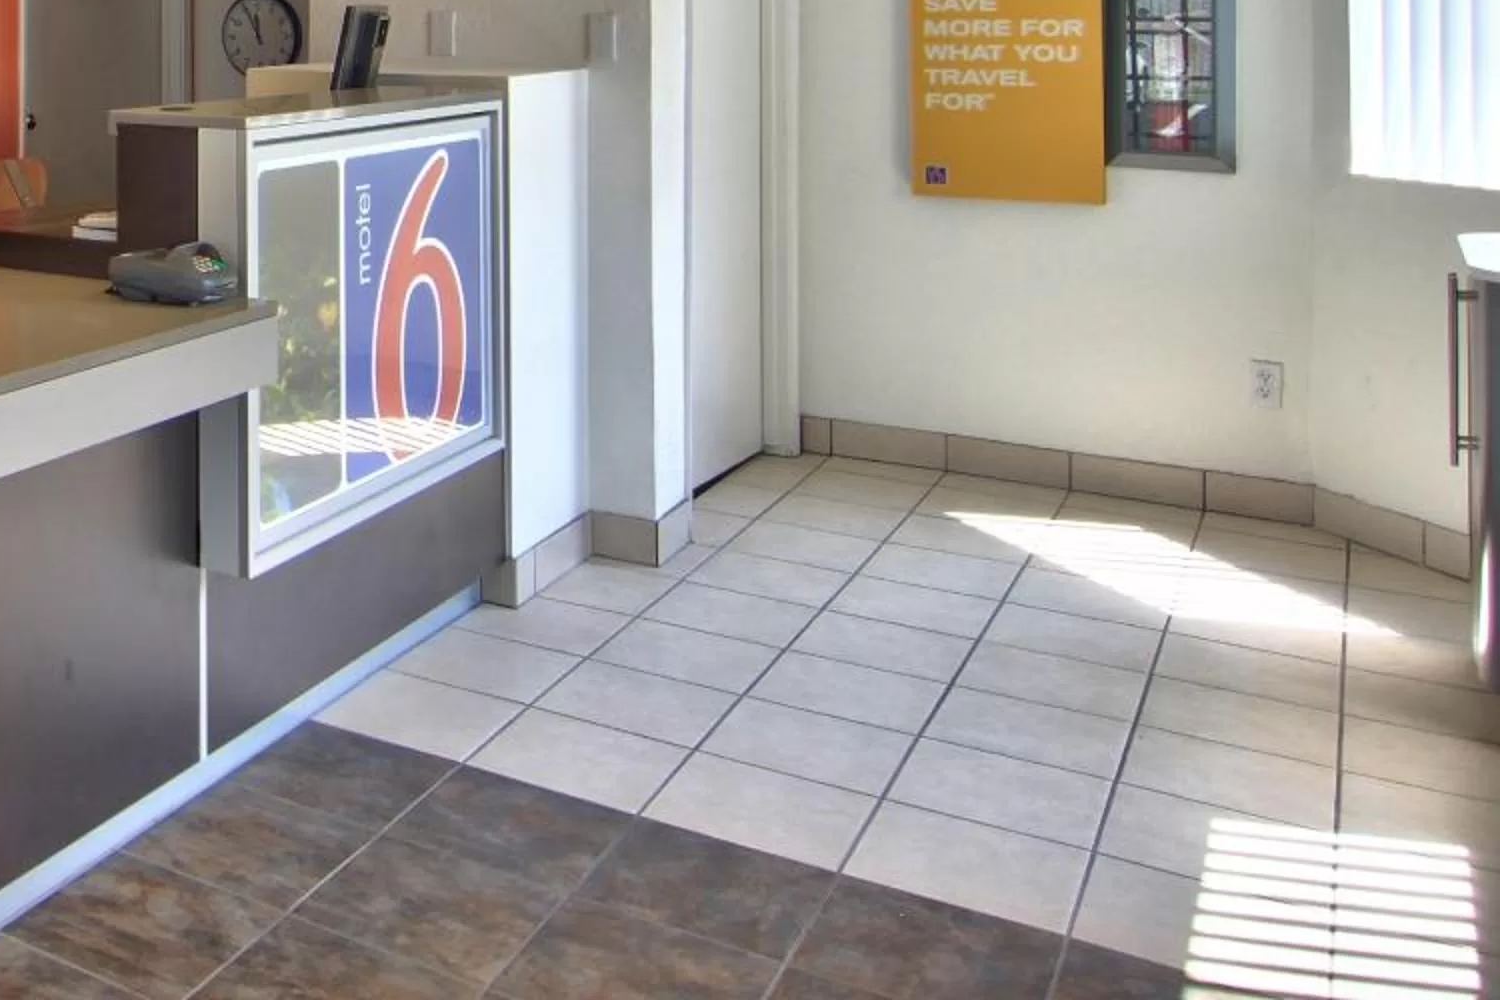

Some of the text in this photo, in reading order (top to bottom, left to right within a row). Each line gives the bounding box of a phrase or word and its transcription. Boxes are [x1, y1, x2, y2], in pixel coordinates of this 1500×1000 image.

[923, 18, 1084, 38] MORE FOR
[924, 43, 1079, 62] WHAT YOU
[924, 68, 1037, 87] TRAVEL
[356, 183, 371, 285] motel
[371, 149, 466, 464] 6
